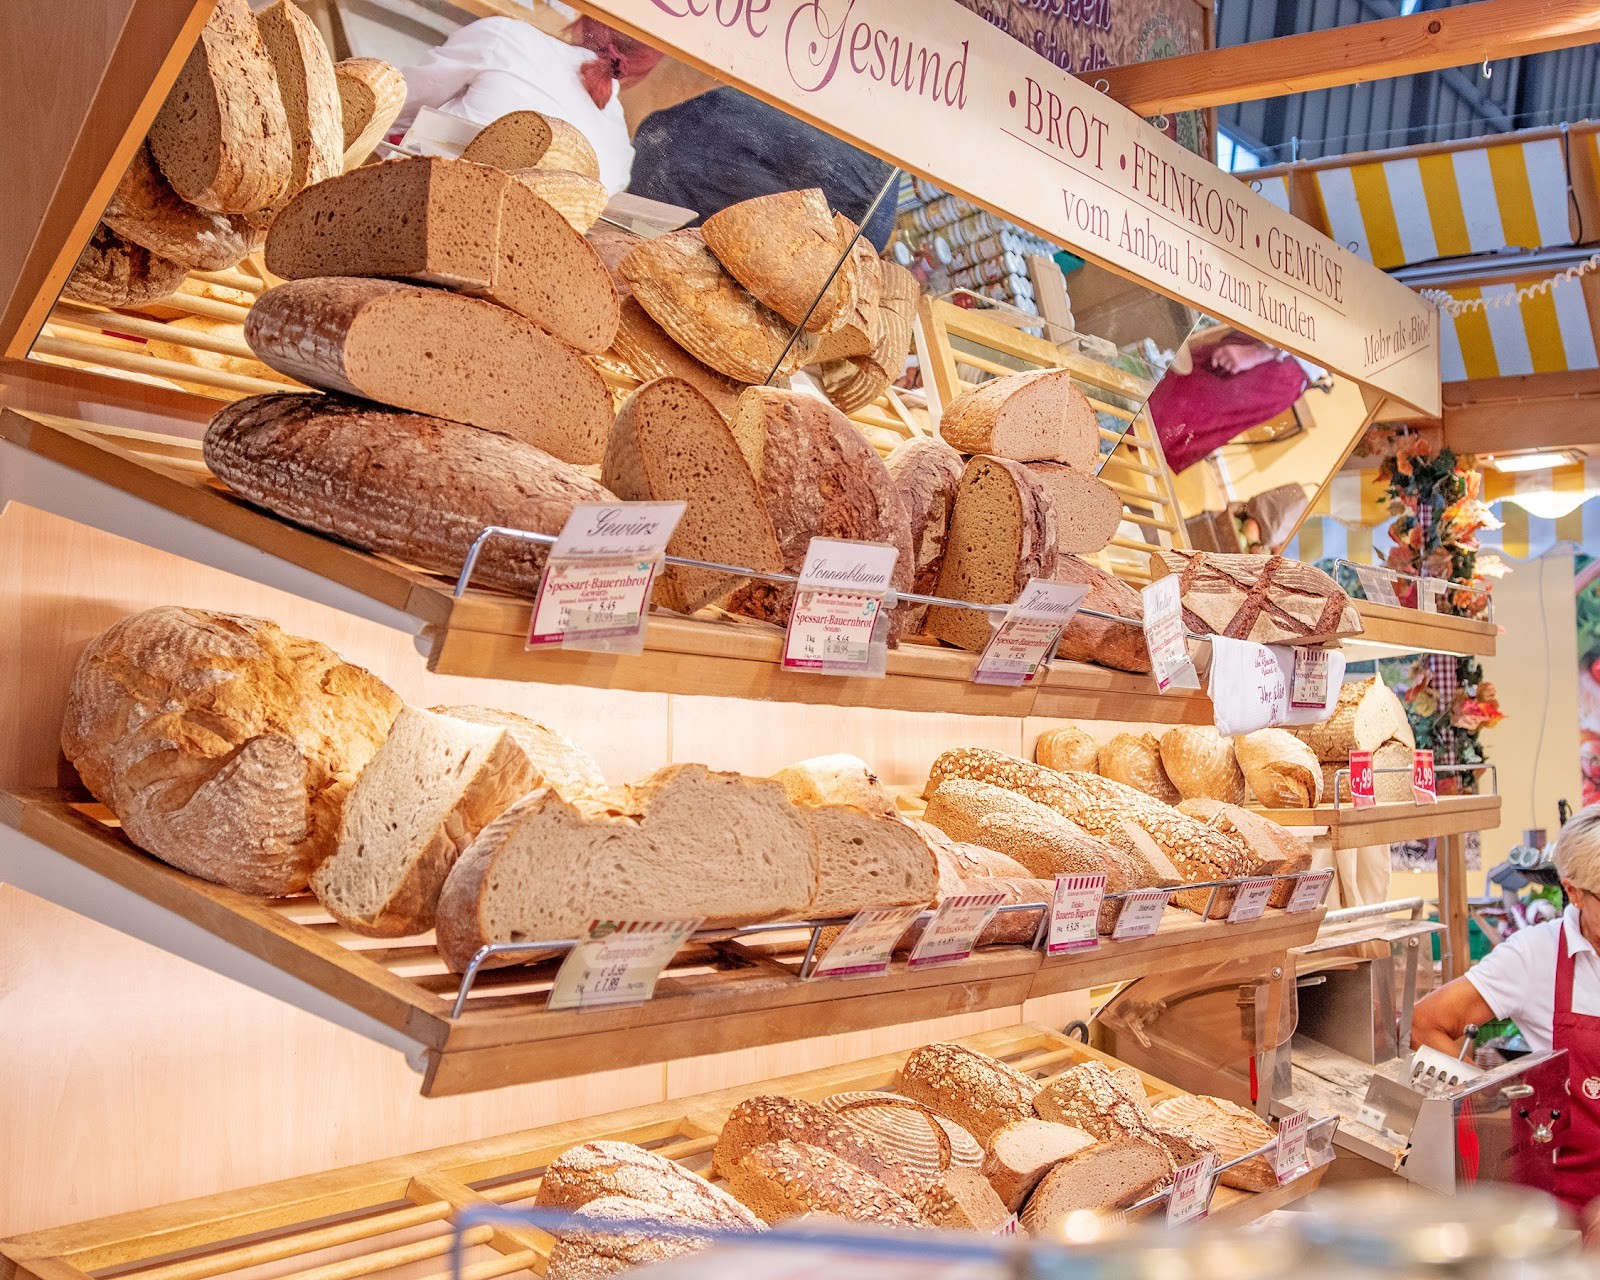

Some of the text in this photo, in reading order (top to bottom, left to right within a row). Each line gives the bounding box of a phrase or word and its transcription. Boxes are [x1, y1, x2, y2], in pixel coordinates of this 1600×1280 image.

[785, 0, 969, 111] Gesund
[1024, 77, 1344, 305] BROT FEINKOST GEMÜSE
[1062, 188, 1316, 342] vom Anbau bis zum Kunden
[1364, 328, 1391, 368] Mehr
[1393, 320, 1407, 354] als
[587, 508, 660, 537] Gewürz
[546, 575, 647, 596] Spessart-Bauernbrot
[805, 558, 887, 585] Sonnenblumen
[795, 611, 872, 628] Spessart-Bauernbrot
